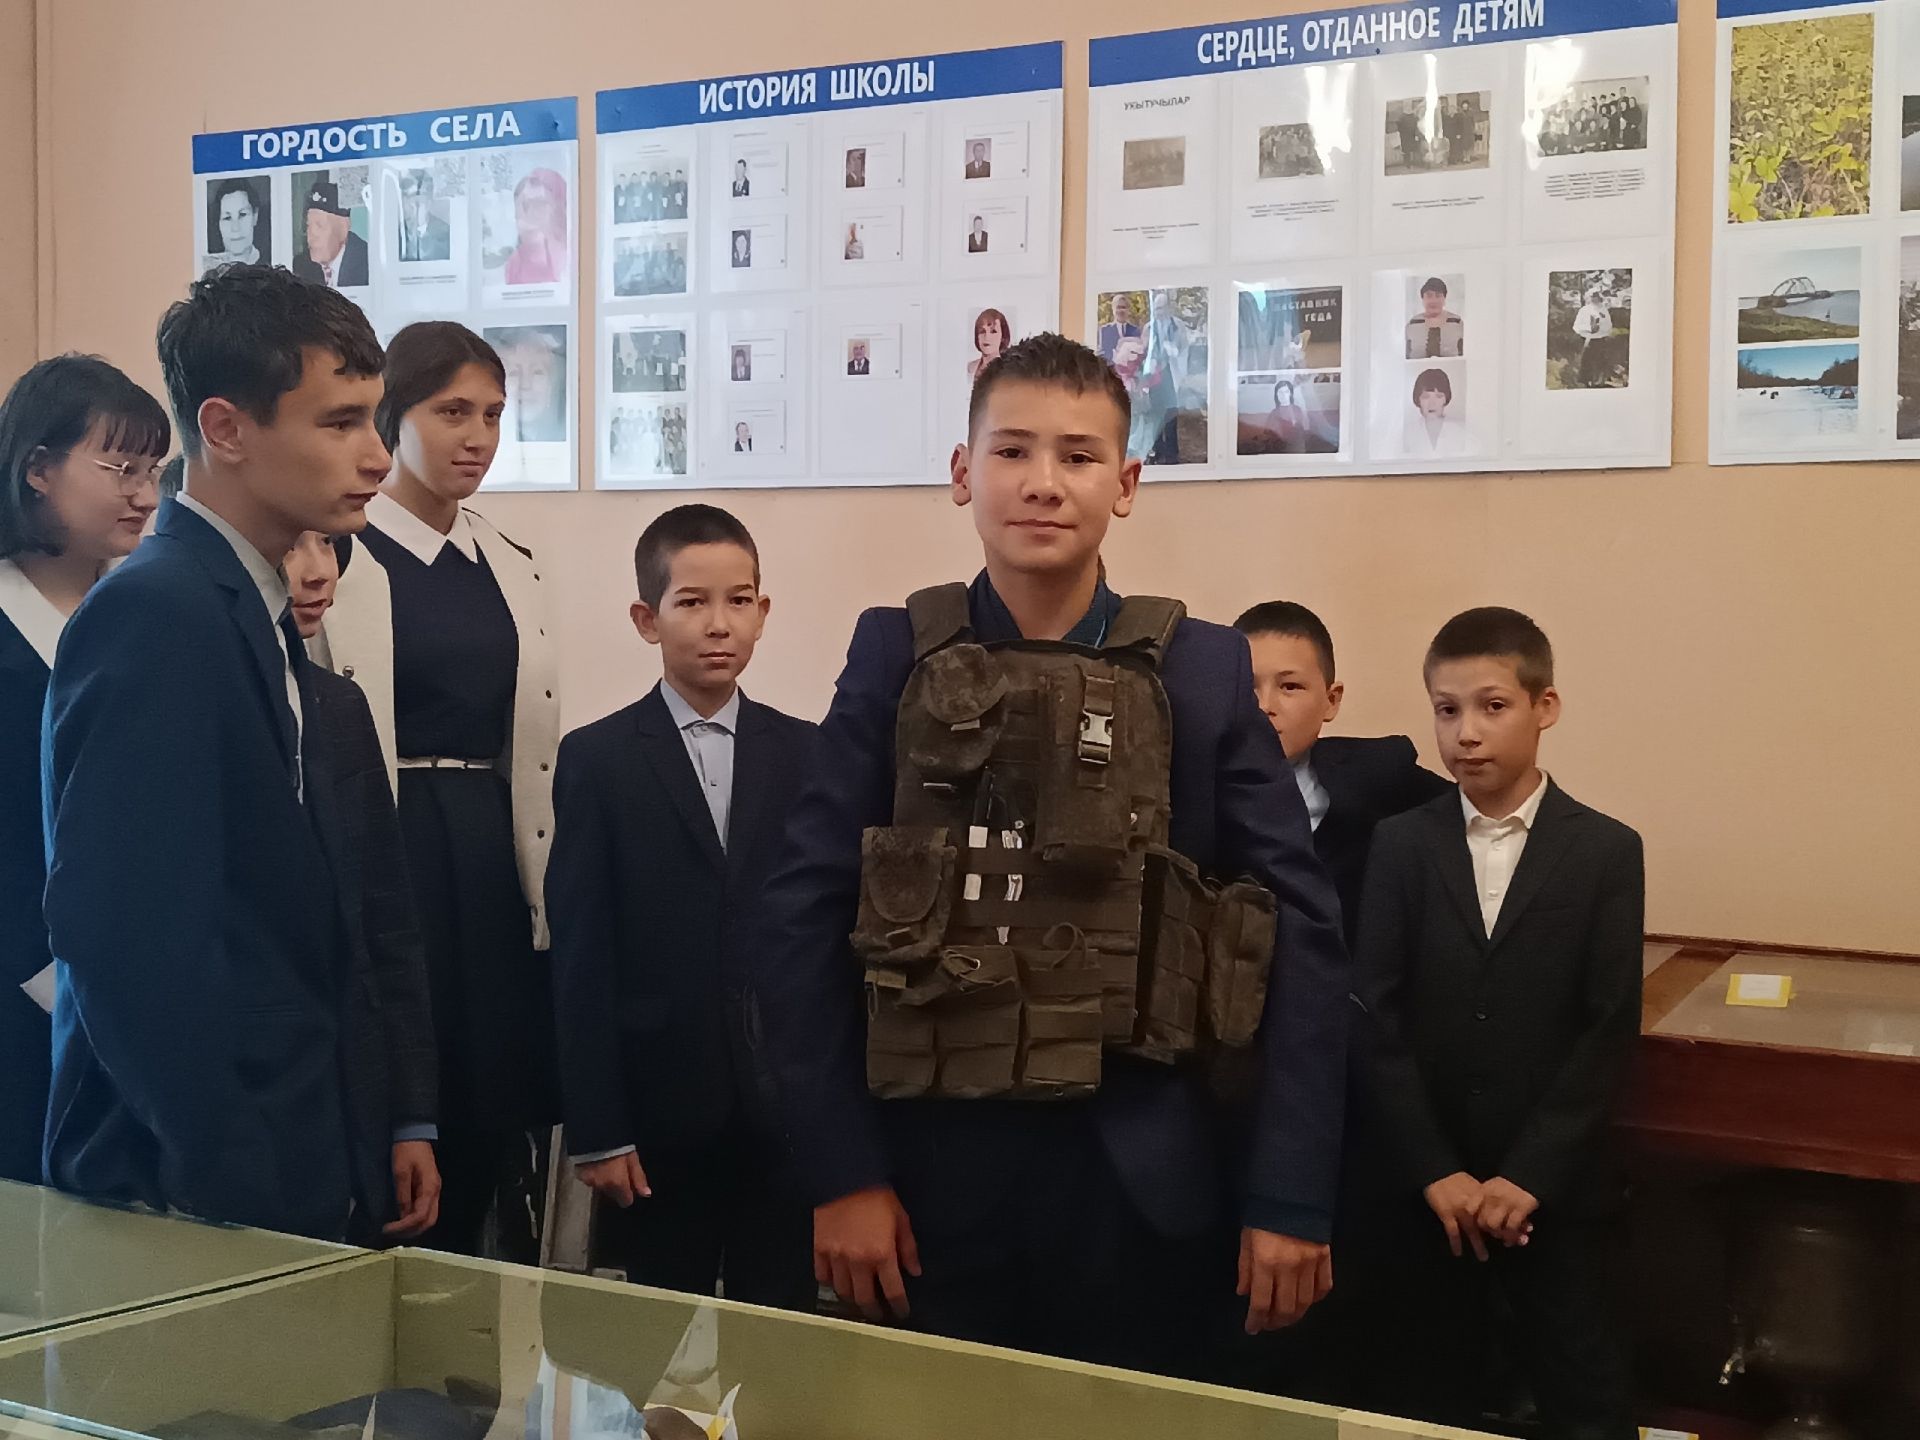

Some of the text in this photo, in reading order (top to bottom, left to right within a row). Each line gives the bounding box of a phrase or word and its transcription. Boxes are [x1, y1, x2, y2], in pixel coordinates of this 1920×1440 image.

[1197, 0, 1544, 67] СЕРДЦЕ, ОТДАННОЕ ДЕТЯМ
[699, 60, 935, 114] ИСТОРИЯ ШКОЛЫ
[242, 111, 521, 161] ГОРДОСТЬ СЕЛА
